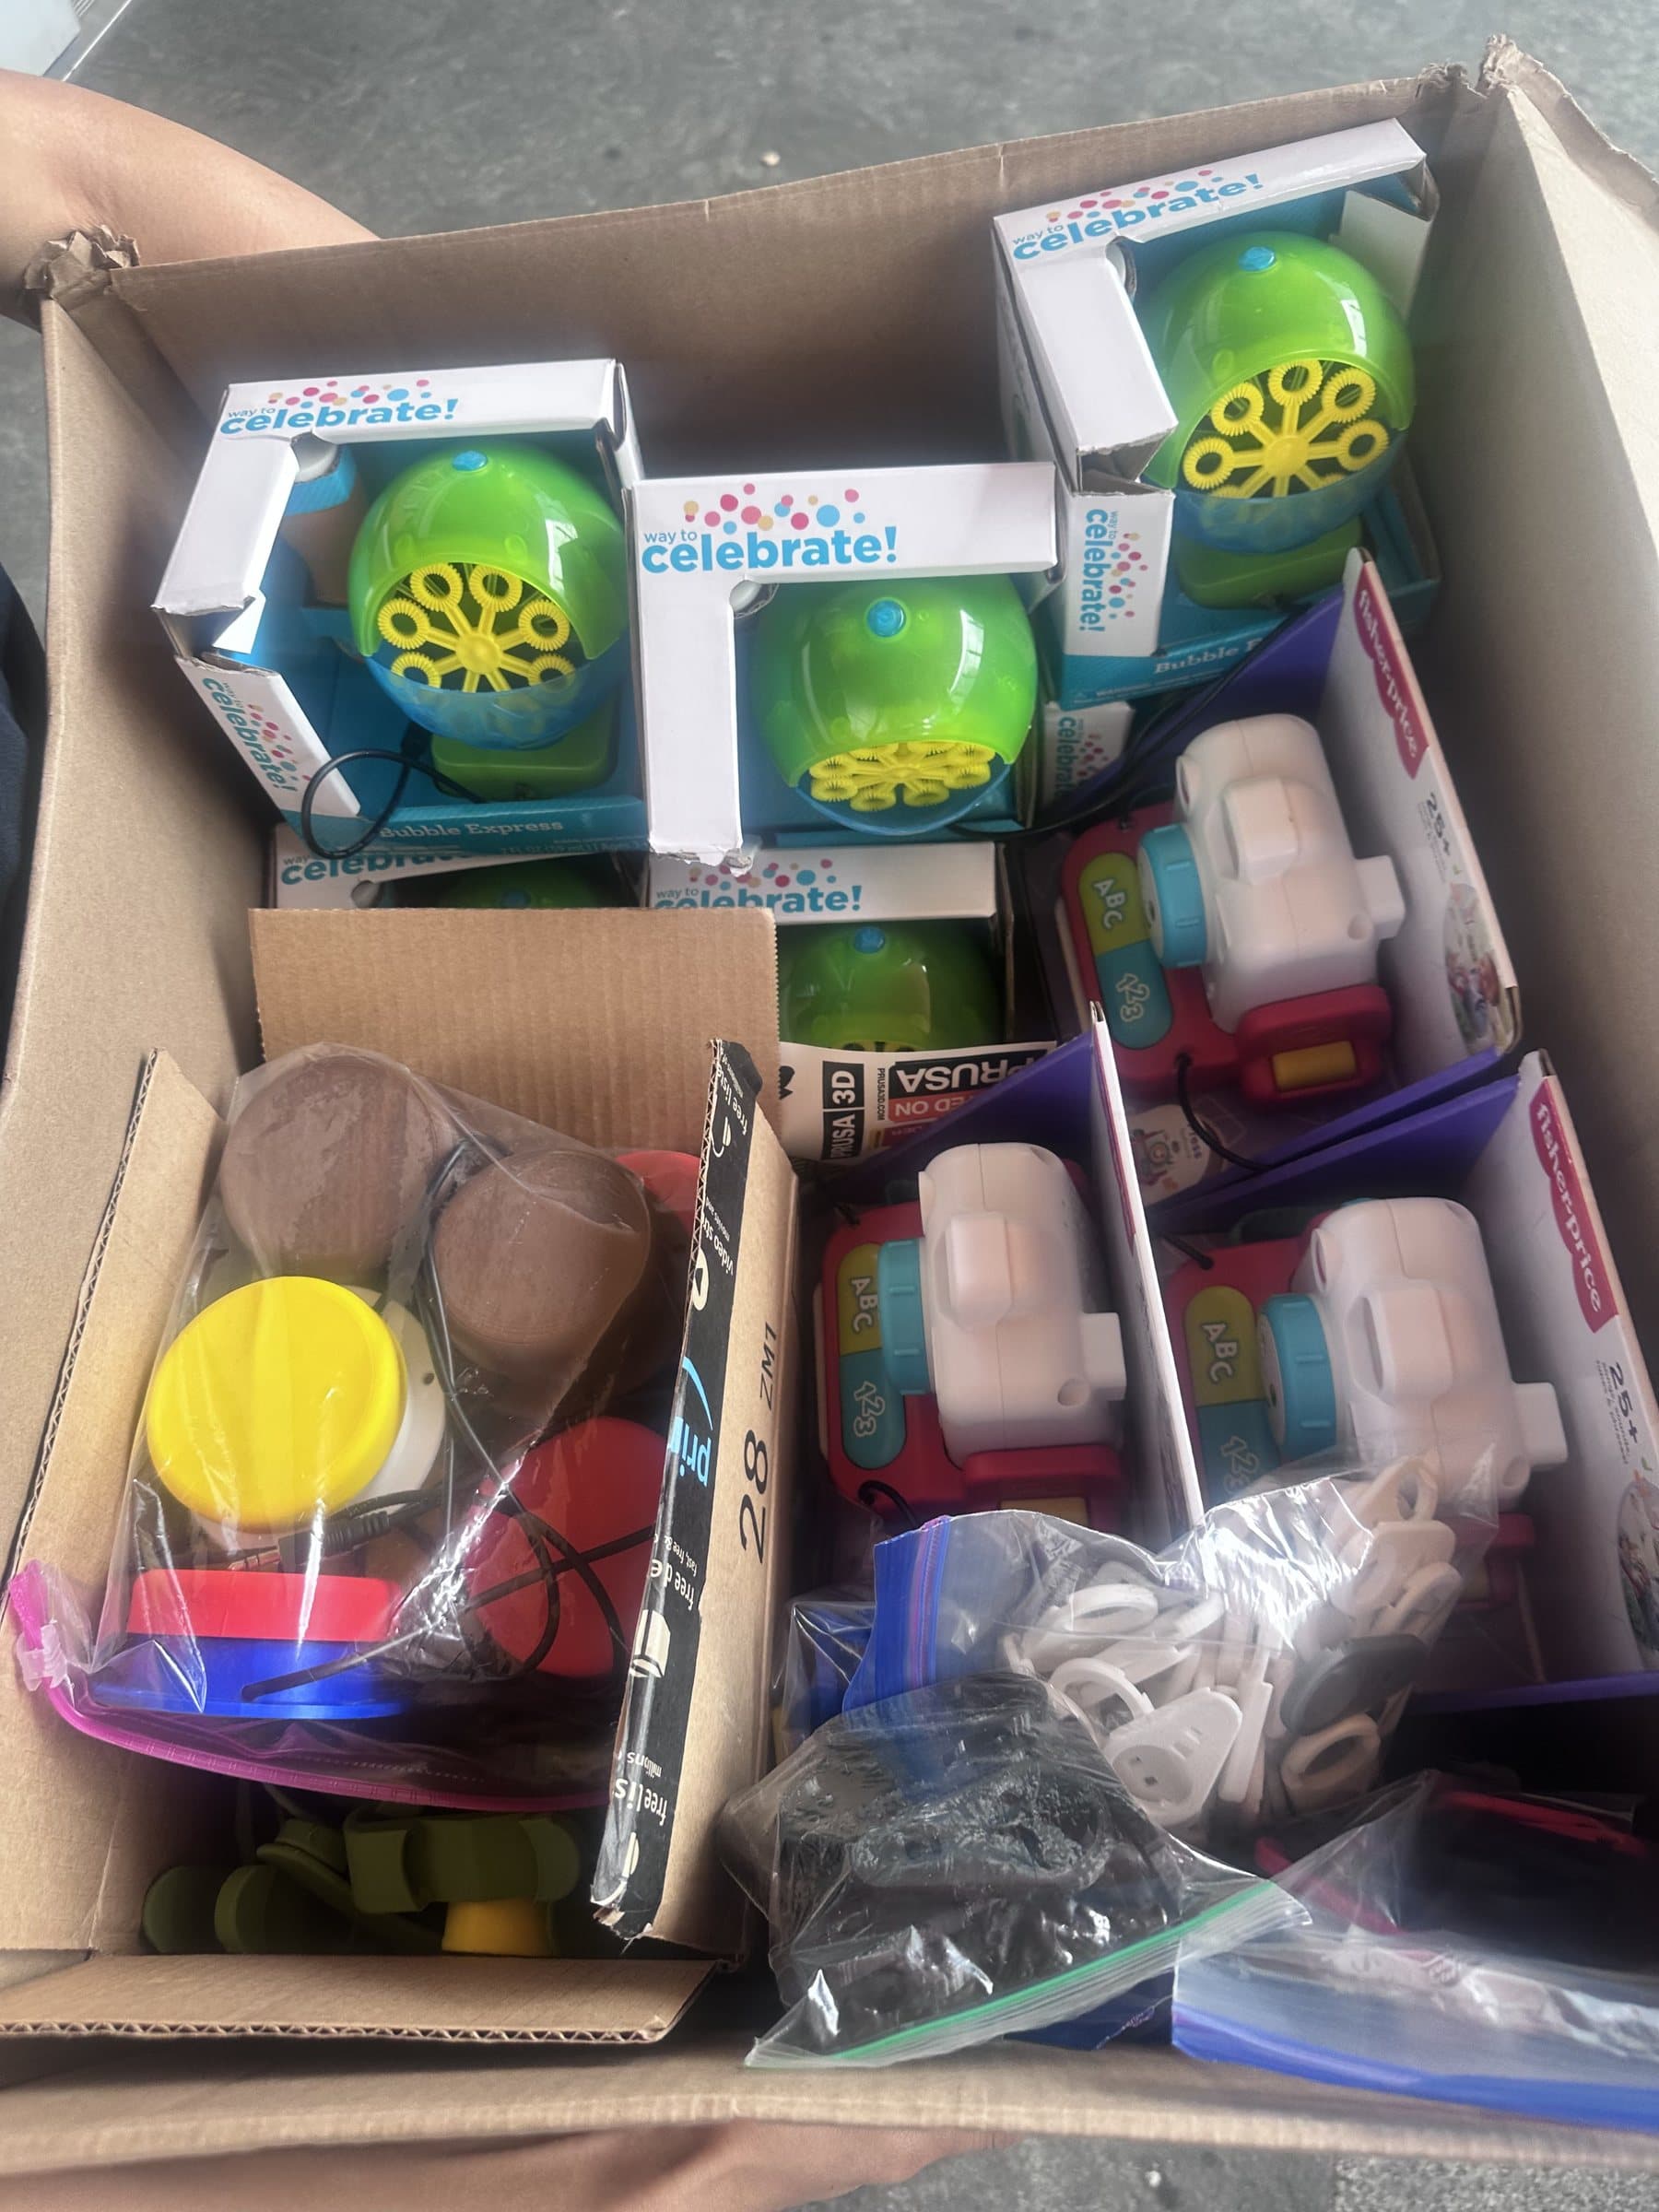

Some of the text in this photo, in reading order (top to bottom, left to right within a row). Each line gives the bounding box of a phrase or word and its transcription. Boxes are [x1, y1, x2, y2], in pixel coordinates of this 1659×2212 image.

[1012, 224, 1064, 245] way to
[1013, 173, 1264, 260] celebrate!
[219, 398, 458, 434] celebrate!
[228, 406, 276, 418] way to
[644, 529, 698, 545] way to
[1107, 511, 1119, 540] way to
[641, 525, 897, 573] celebrate!
[1079, 509, 1113, 631] celebrate!
[1154, 646, 1240, 674] Bubble
[202, 677, 298, 792] celebrate!
[379, 821, 564, 838] Bubble Express
[283, 853, 310, 865] way
[656, 888, 699, 900] way to
[1093, 878, 1125, 929] ABC
[1116, 973, 1150, 1022] 123
[733, 1097, 747, 1135] free
[831, 1070, 855, 1159] PRUSA 3D
[895, 1100, 930, 1117] ON
[1537, 1104, 1601, 1312] fisher-price
[714, 1235, 735, 1276] video
[852, 1277, 878, 1332] ABC
[1202, 1323, 1238, 1382] ABC
[853, 1381, 885, 1437] 123
[1609, 1362, 1637, 1443] 25+
[667, 1416, 712, 1487] pri
[739, 1430, 769, 1564] 28
[673, 1541, 685, 1564] free
[675, 1571, 694, 1610] free
[644, 1788, 667, 1826] free
